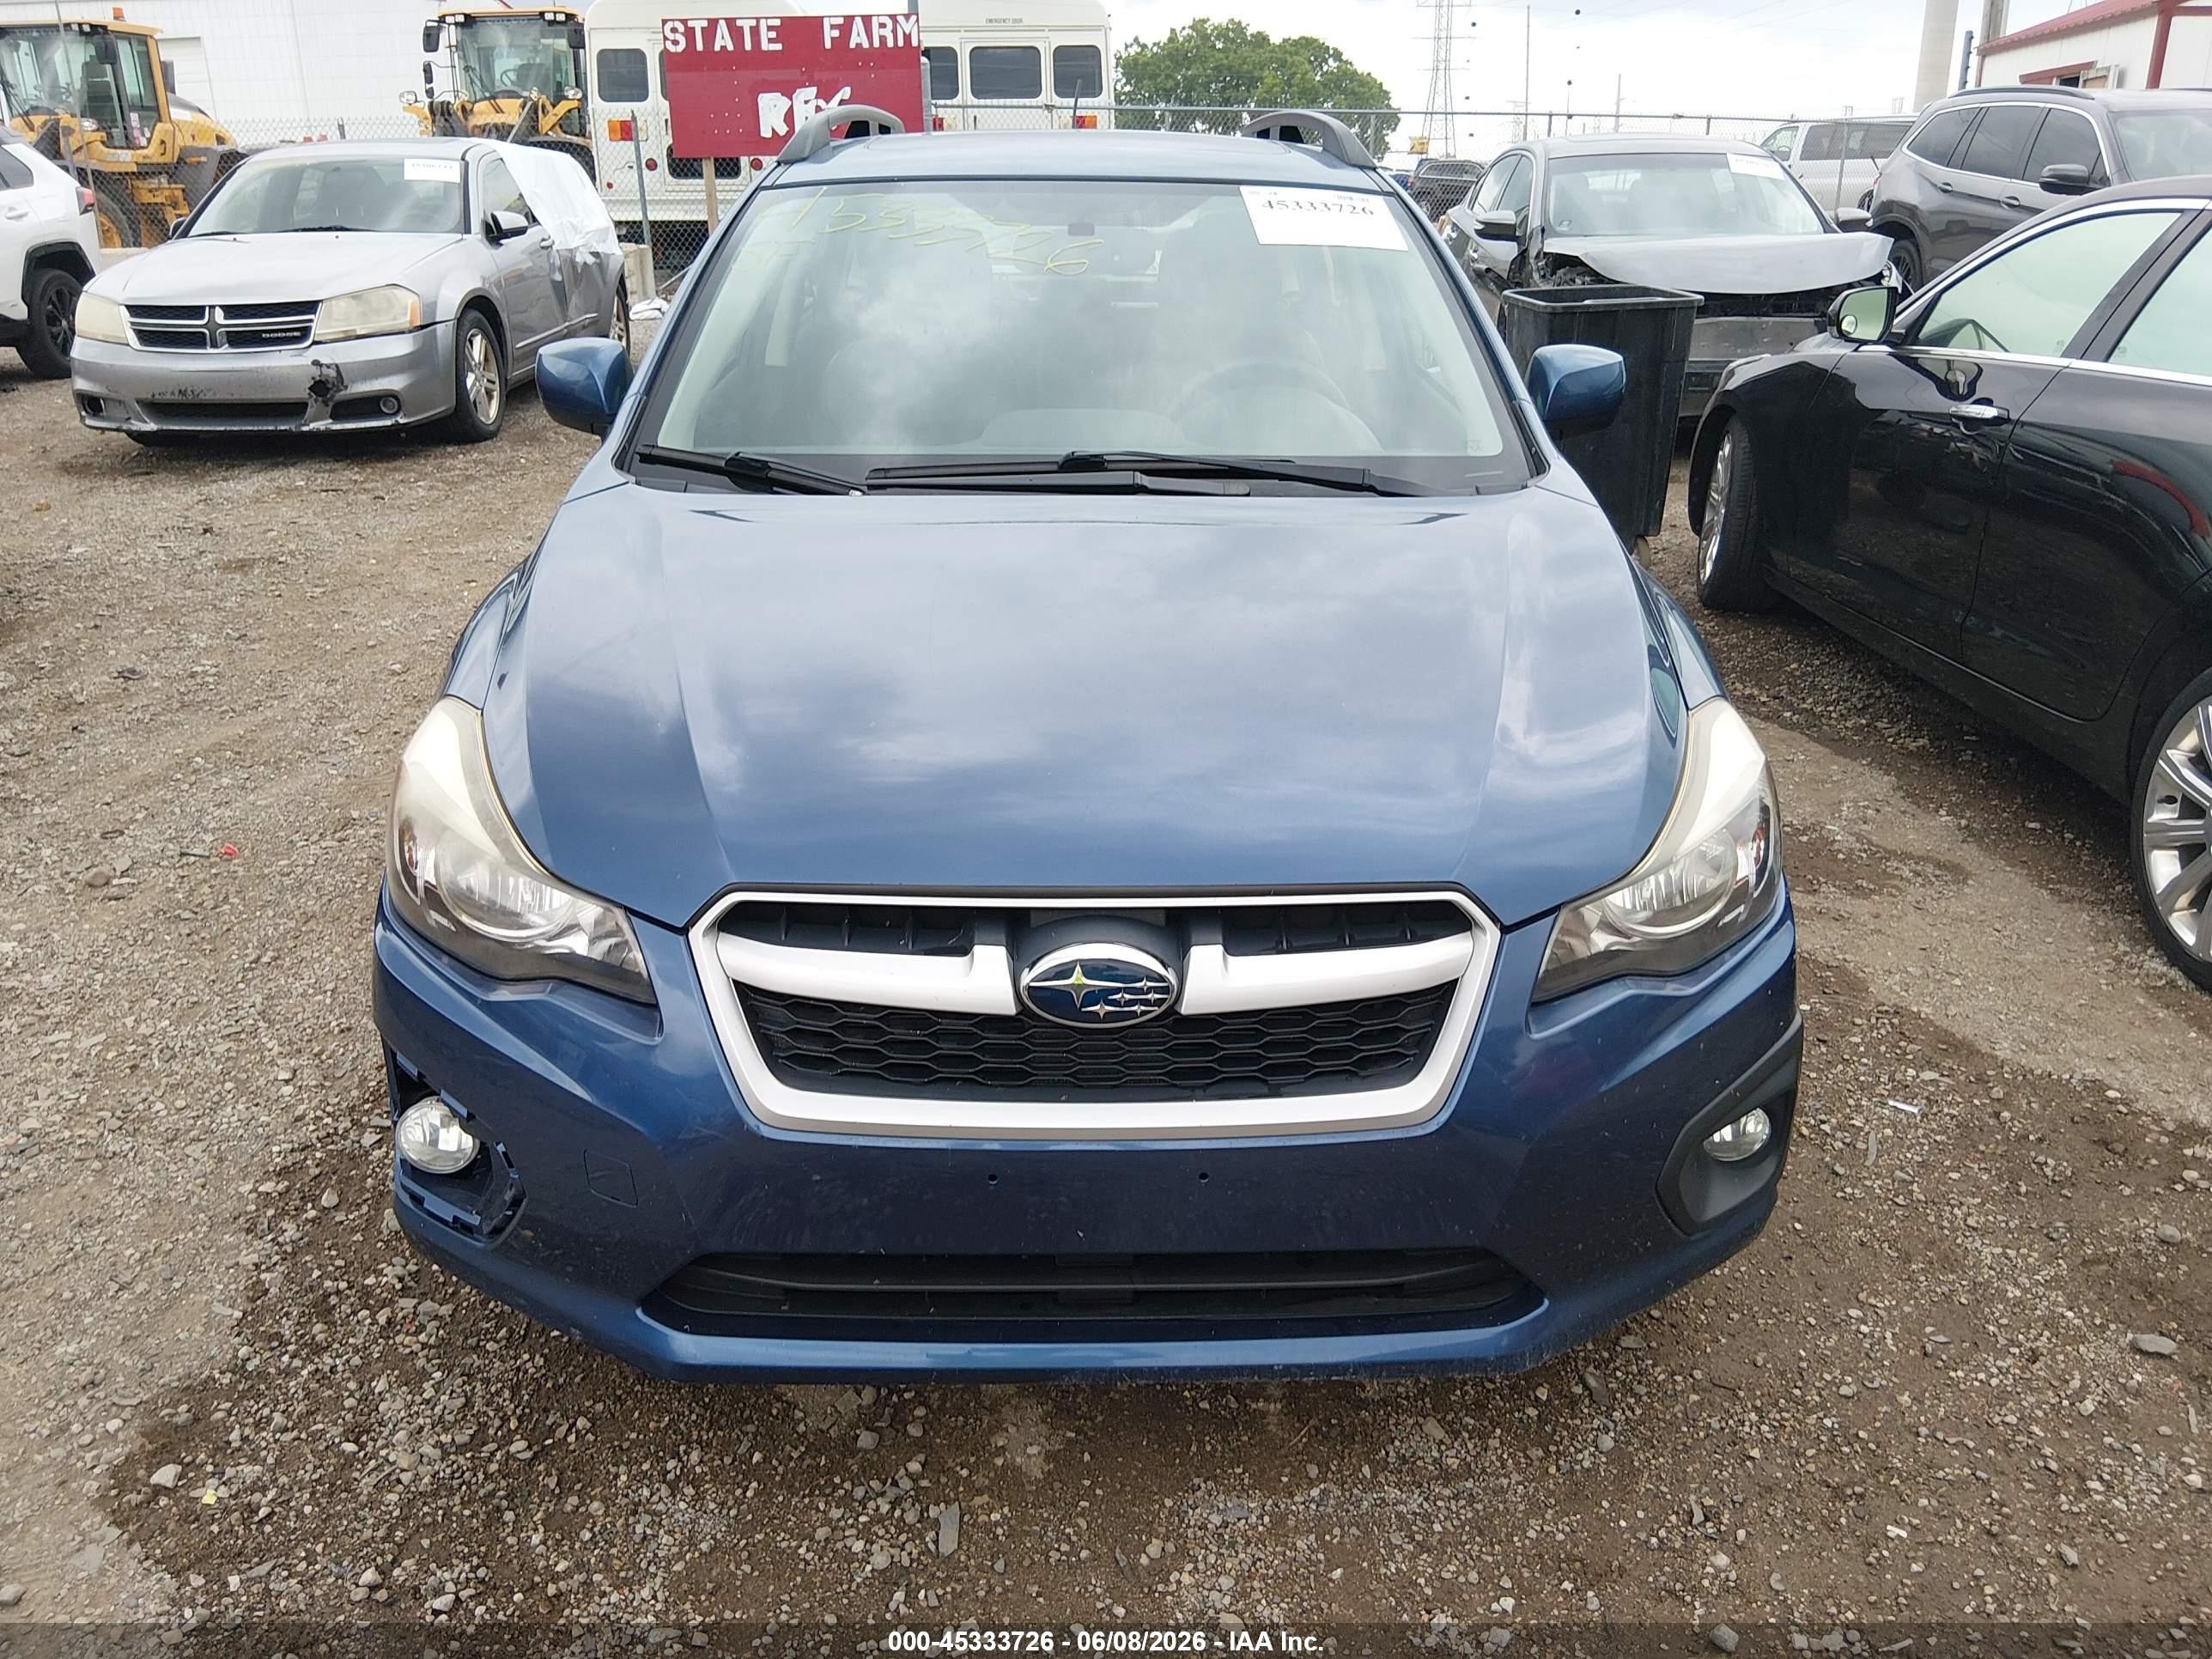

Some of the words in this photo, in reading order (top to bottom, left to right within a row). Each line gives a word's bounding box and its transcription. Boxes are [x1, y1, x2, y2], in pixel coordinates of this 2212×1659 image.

[663, 18, 783, 53] STATE
[823, 15, 919, 50] FARM
[1261, 199, 1375, 216] 45333726
